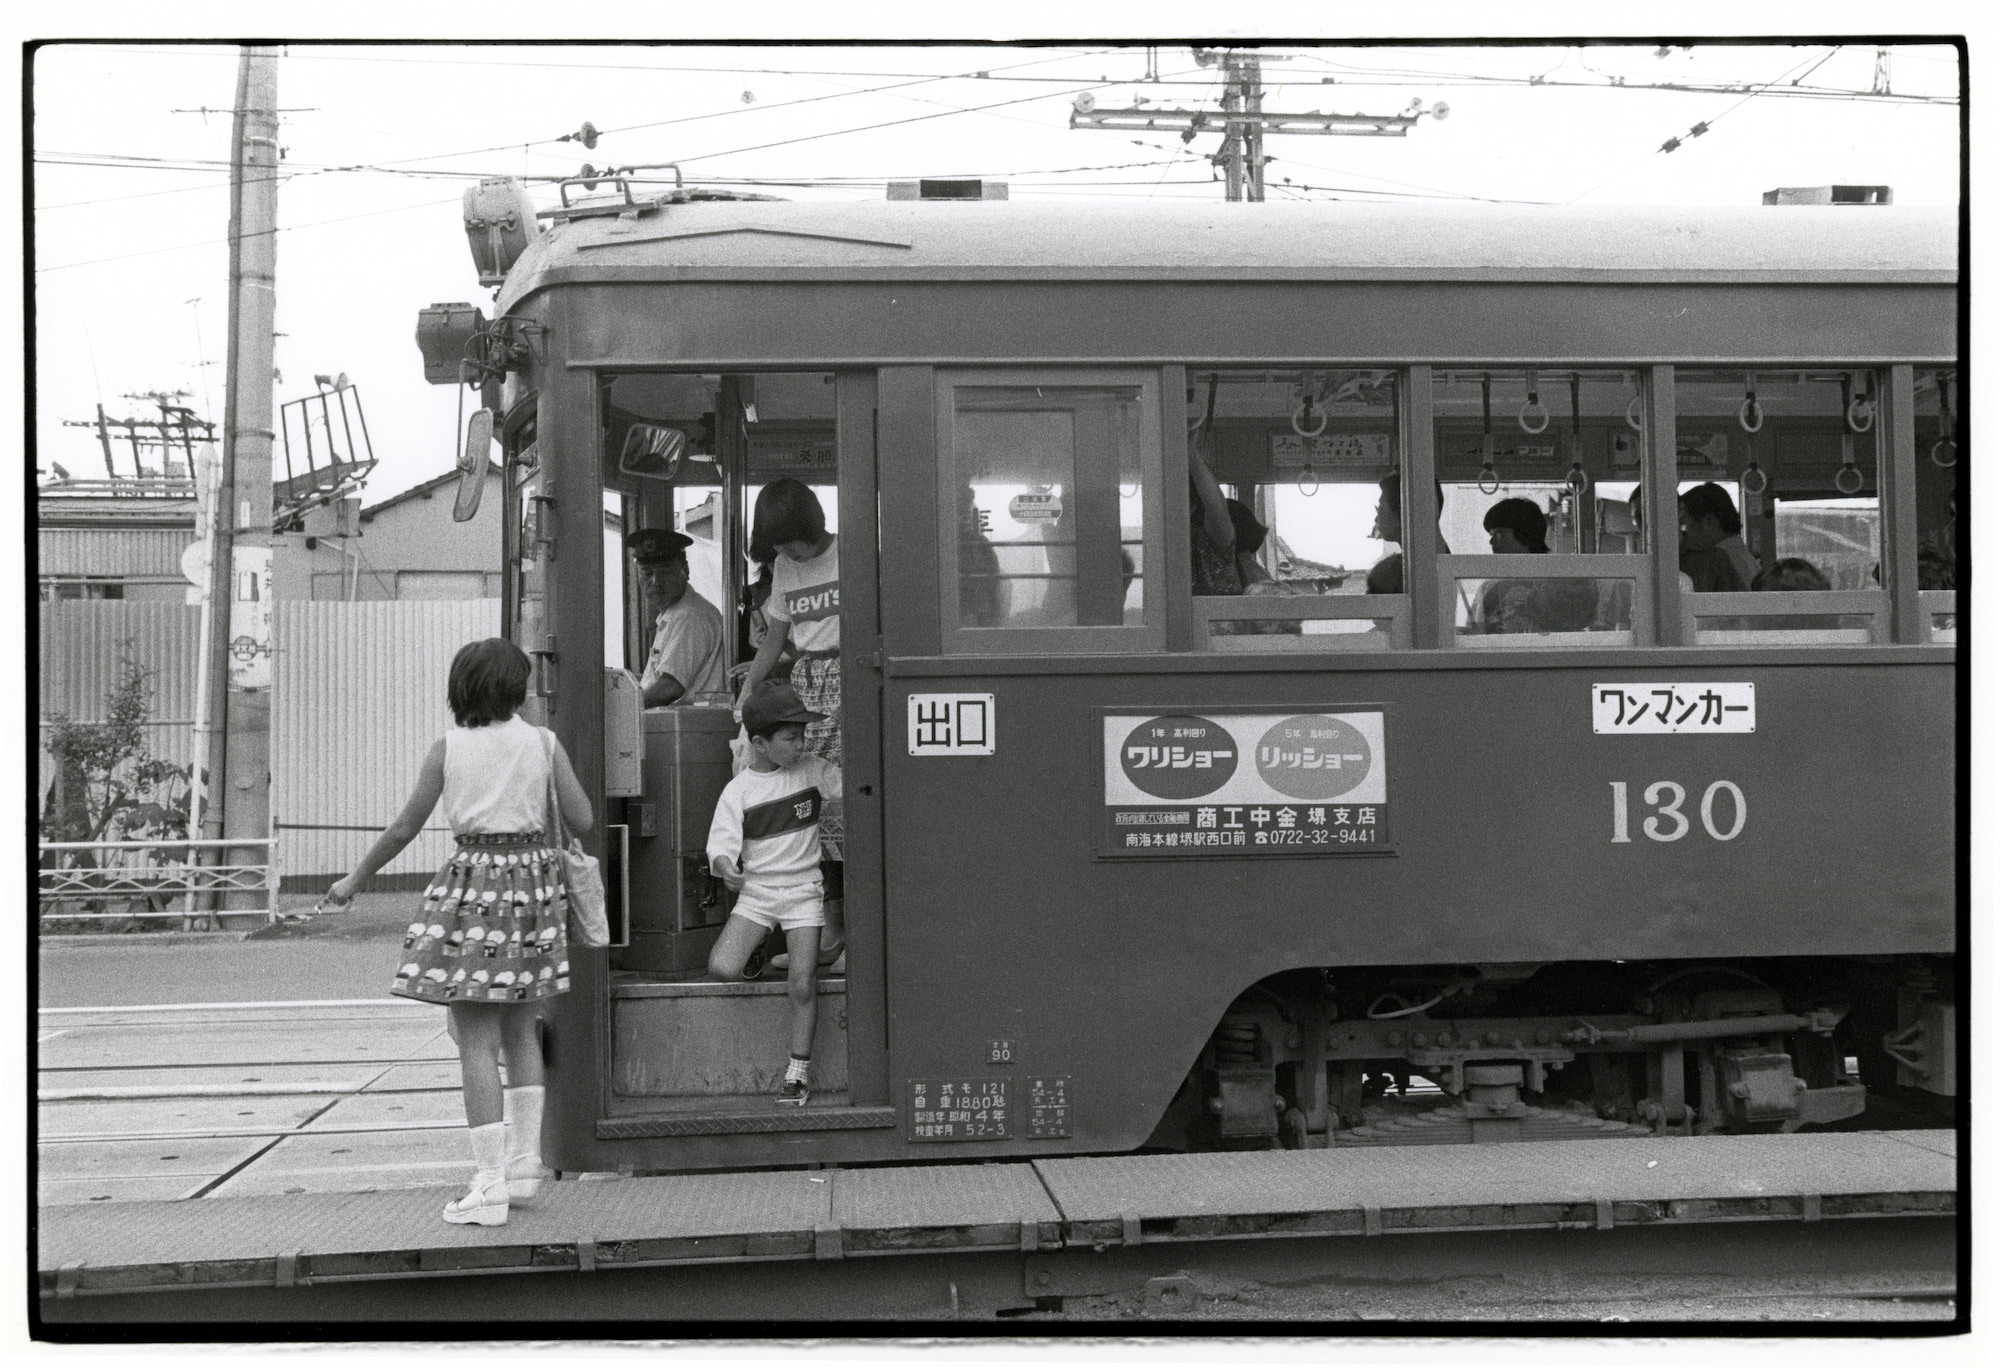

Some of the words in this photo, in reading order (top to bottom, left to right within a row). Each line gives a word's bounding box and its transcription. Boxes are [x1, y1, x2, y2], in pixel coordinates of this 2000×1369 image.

[1601, 690, 1748, 725] ワンマンカー
[917, 700, 986, 748] 出口
[1173, 727, 1206, 738] 高利回り
[1128, 746, 1233, 769] ワリショー
[1262, 746, 1363, 769] リッショー
[1197, 807, 1297, 828] 商工中金
[1308, 807, 1376, 825] 堺支店
[1609, 780, 1746, 842] 130
[1126, 831, 1246, 847] 南海本線堺駅西口前
[1271, 829, 1375, 845] 0722-32-9441
[992, 1049, 1010, 1061] 90
[966, 1123, 1005, 1136] 52-3
